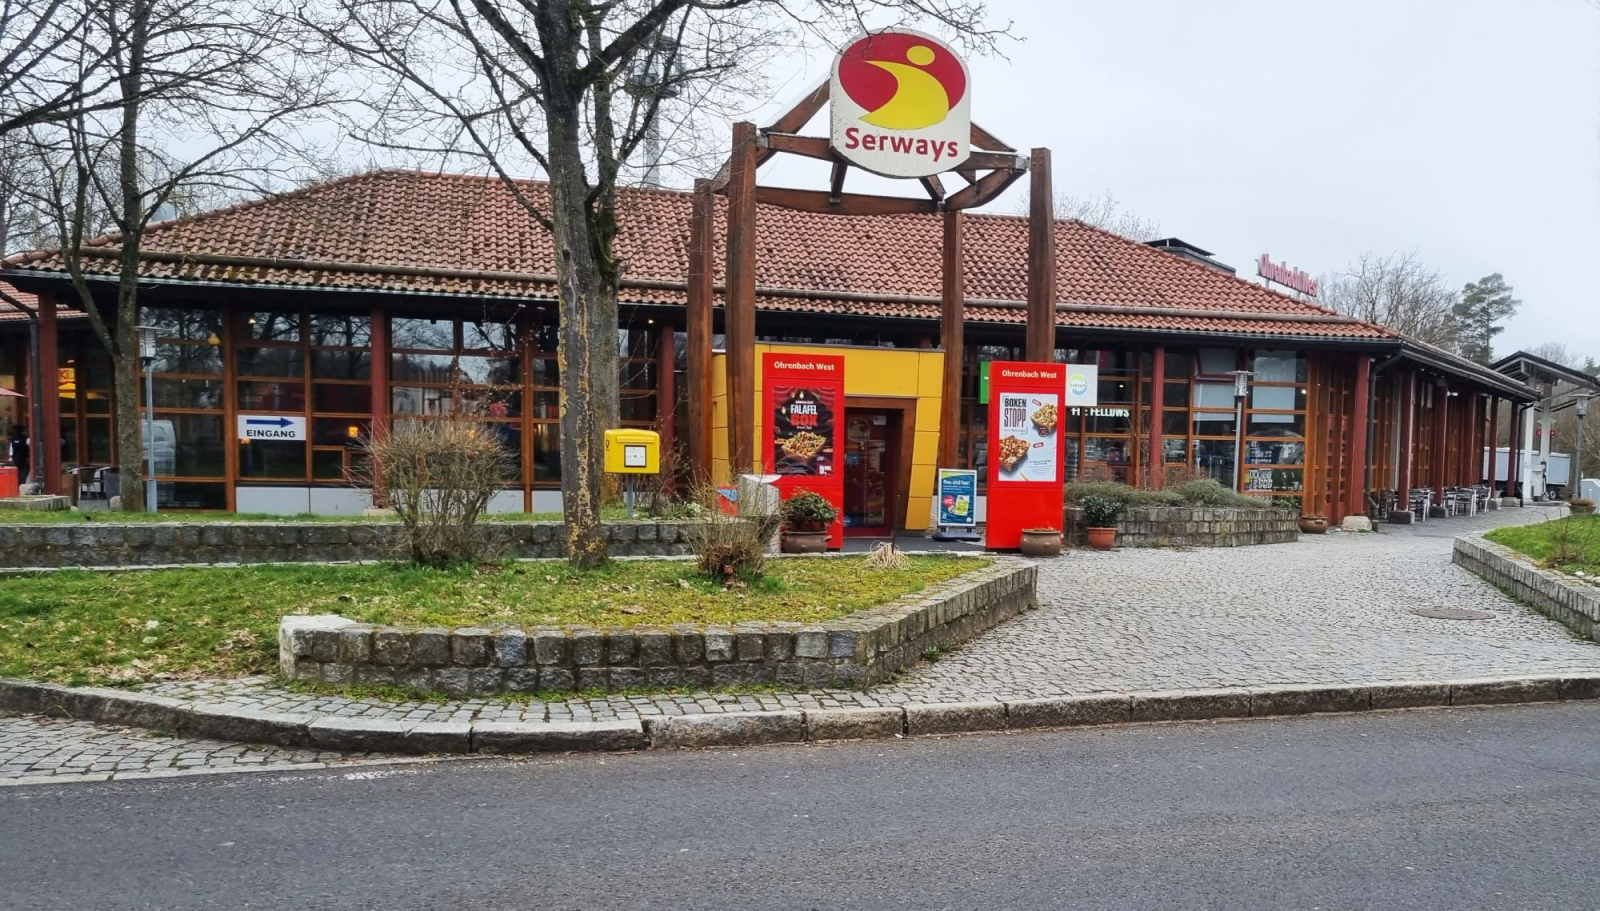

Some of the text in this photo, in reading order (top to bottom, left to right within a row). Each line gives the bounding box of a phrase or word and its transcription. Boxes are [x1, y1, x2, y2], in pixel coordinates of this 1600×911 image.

[845, 127, 958, 162] Serways
[774, 361, 835, 371] Ohrenbach West
[1002, 369, 1057, 379] Ohrenbach West
[1004, 398, 1027, 408] BOXEN
[790, 404, 818, 414] FALAFEL
[1090, 407, 1130, 418] FELLOWS
[791, 414, 818, 426] BOX
[1004, 408, 1027, 427] STOPP
[246, 429, 296, 438] EINGANG
